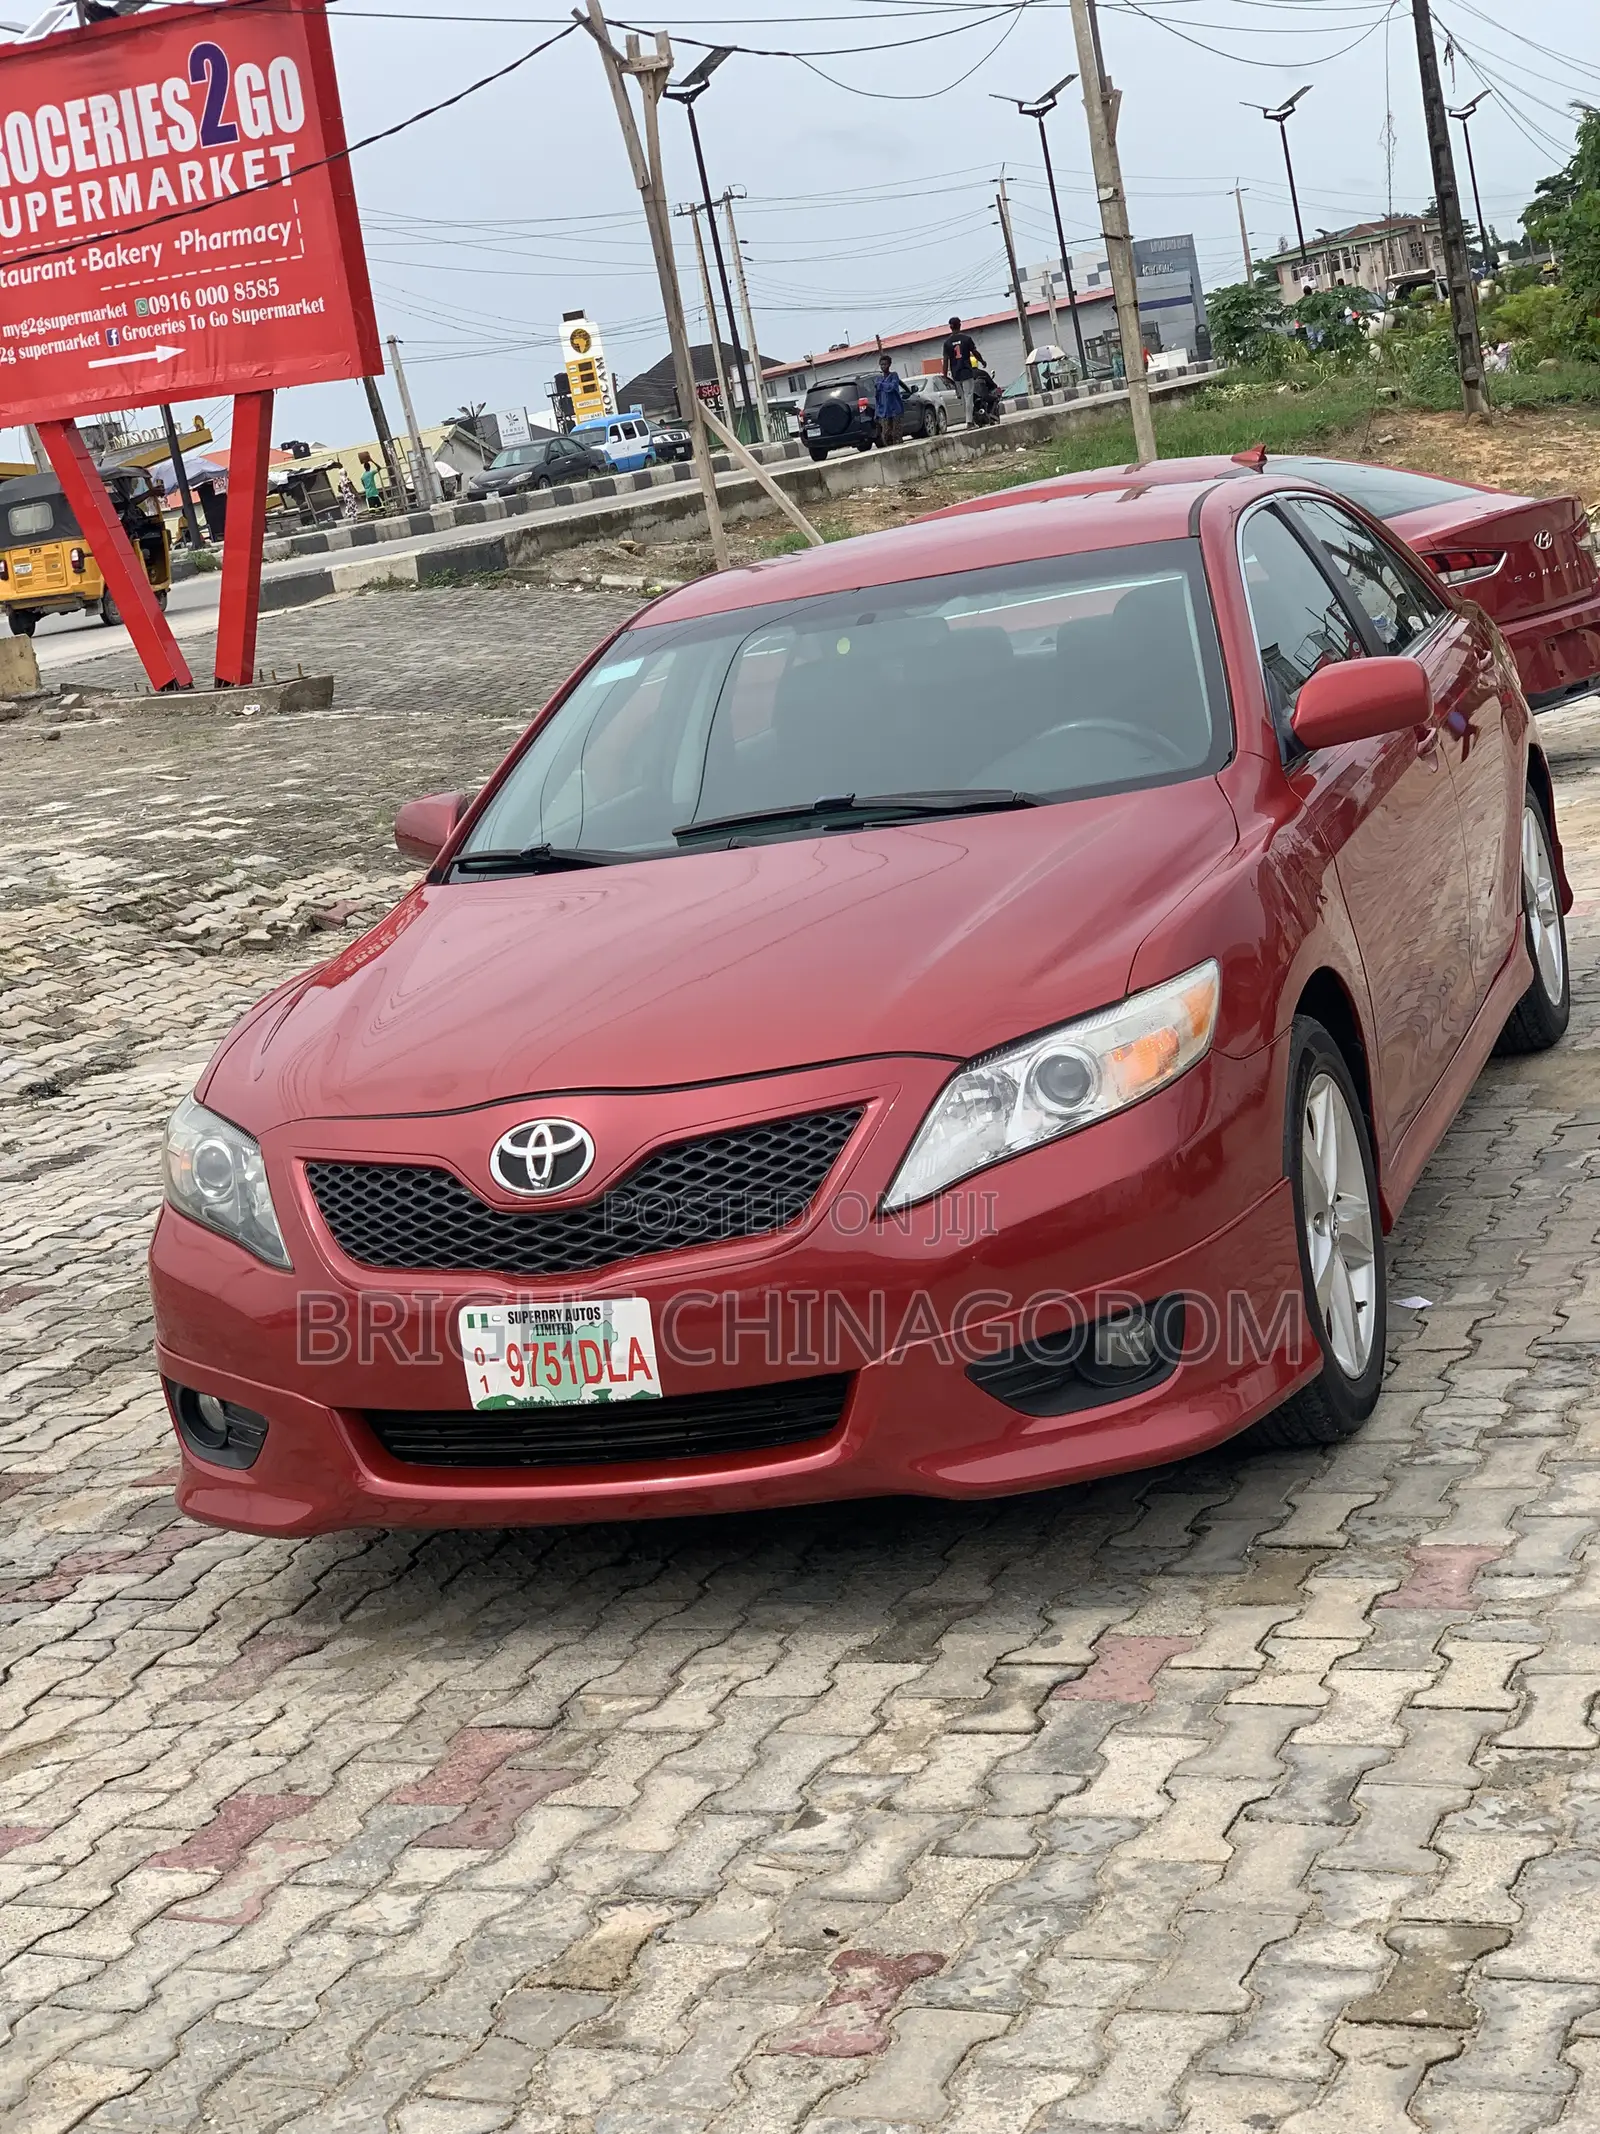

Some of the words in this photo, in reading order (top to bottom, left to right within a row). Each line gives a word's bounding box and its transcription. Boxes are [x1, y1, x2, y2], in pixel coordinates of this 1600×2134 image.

[2, 301, 128, 339] myg2gsupermarket
[149, 291, 191, 315] 0916
[195, 284, 229, 307] 000
[233, 277, 280, 301] 8585
[18, 331, 101, 360] supermarket
[122, 318, 186, 341] Groceries
[188, 314, 206, 331] To
[209, 311, 229, 328] Go
[232, 296, 326, 325] Supermarket
[1514, 559, 1580, 583] SONATA
[507, 1309, 563, 1325] SUPERDRY
[565, 1306, 602, 1322] AUTOS
[506, 1336, 654, 1388] 9751DLA
